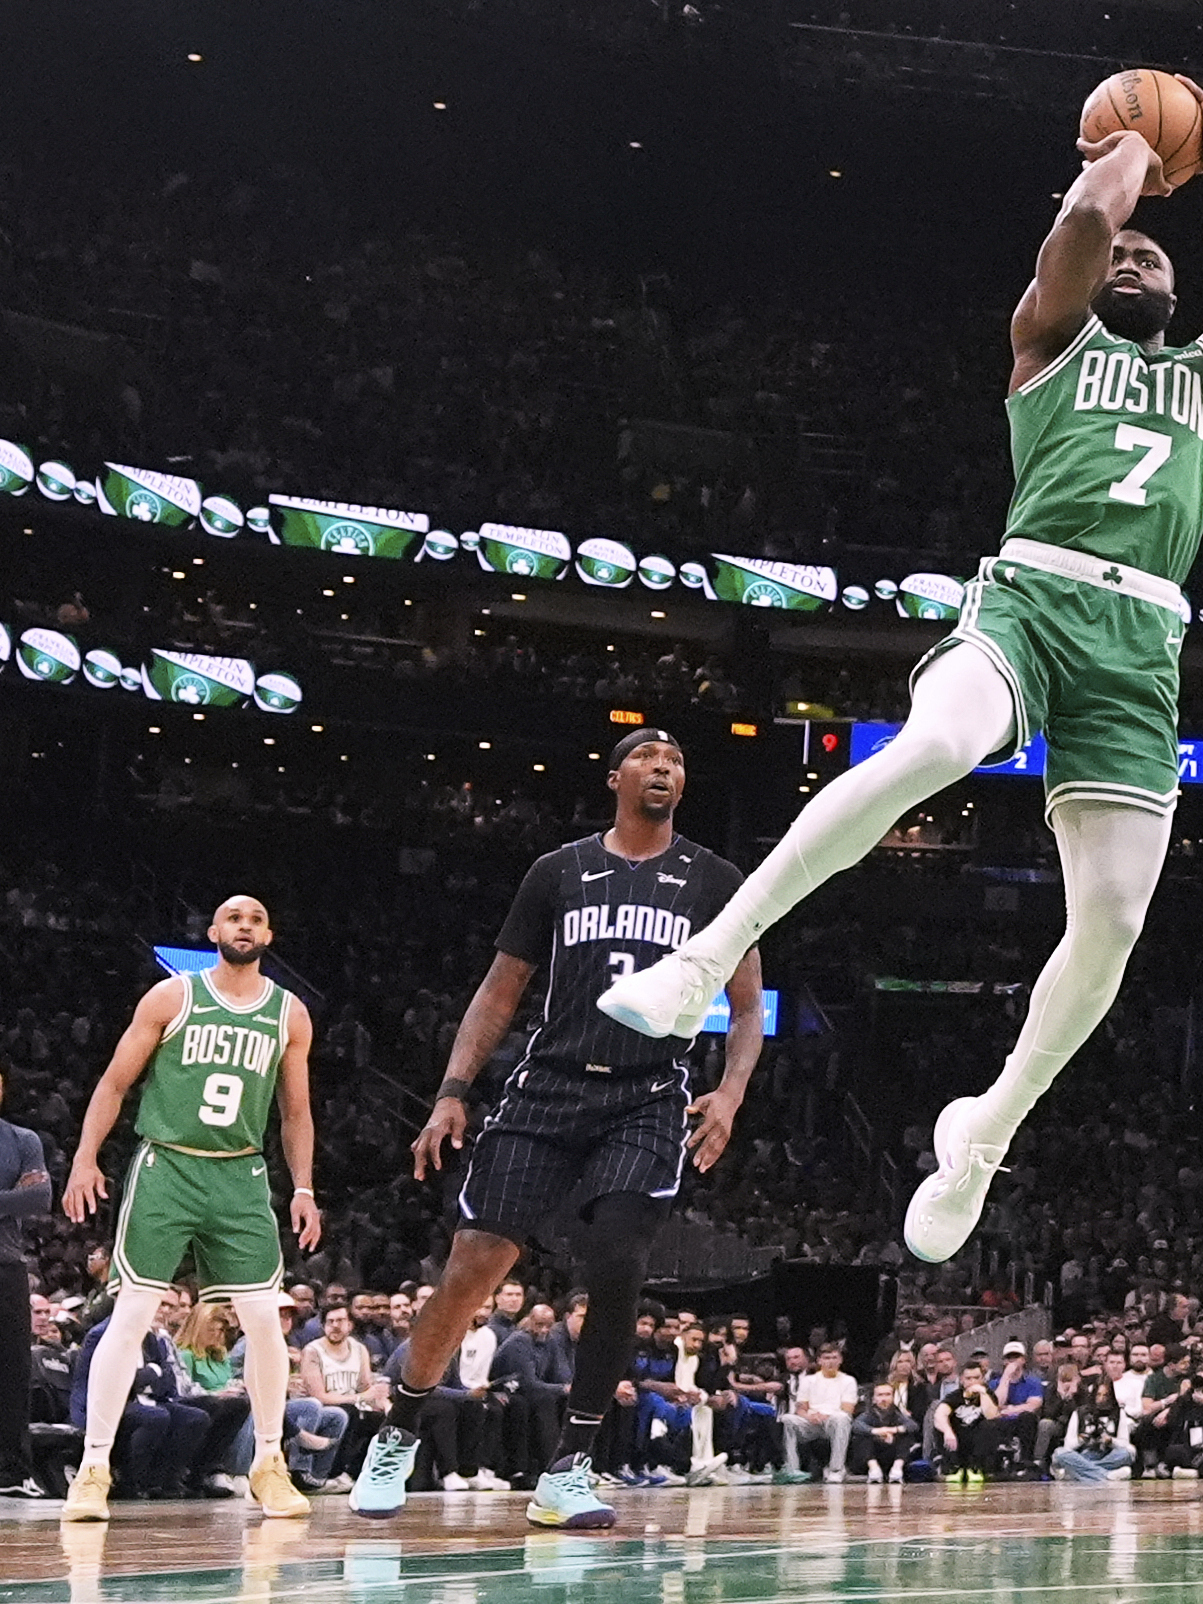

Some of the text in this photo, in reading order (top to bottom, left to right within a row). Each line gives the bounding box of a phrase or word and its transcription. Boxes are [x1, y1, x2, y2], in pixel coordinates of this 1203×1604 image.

[1119, 70, 1142, 121] ilson
[1108, 422, 1173, 506] 7
[488, 528, 563, 555] TEMPLETON
[908, 583, 959, 604] TEMPLETO
[822, 733, 838, 752] 9
[564, 904, 691, 951] ORLANDO
[181, 1024, 276, 1077] BOSTON
[198, 1072, 244, 1127] 9
